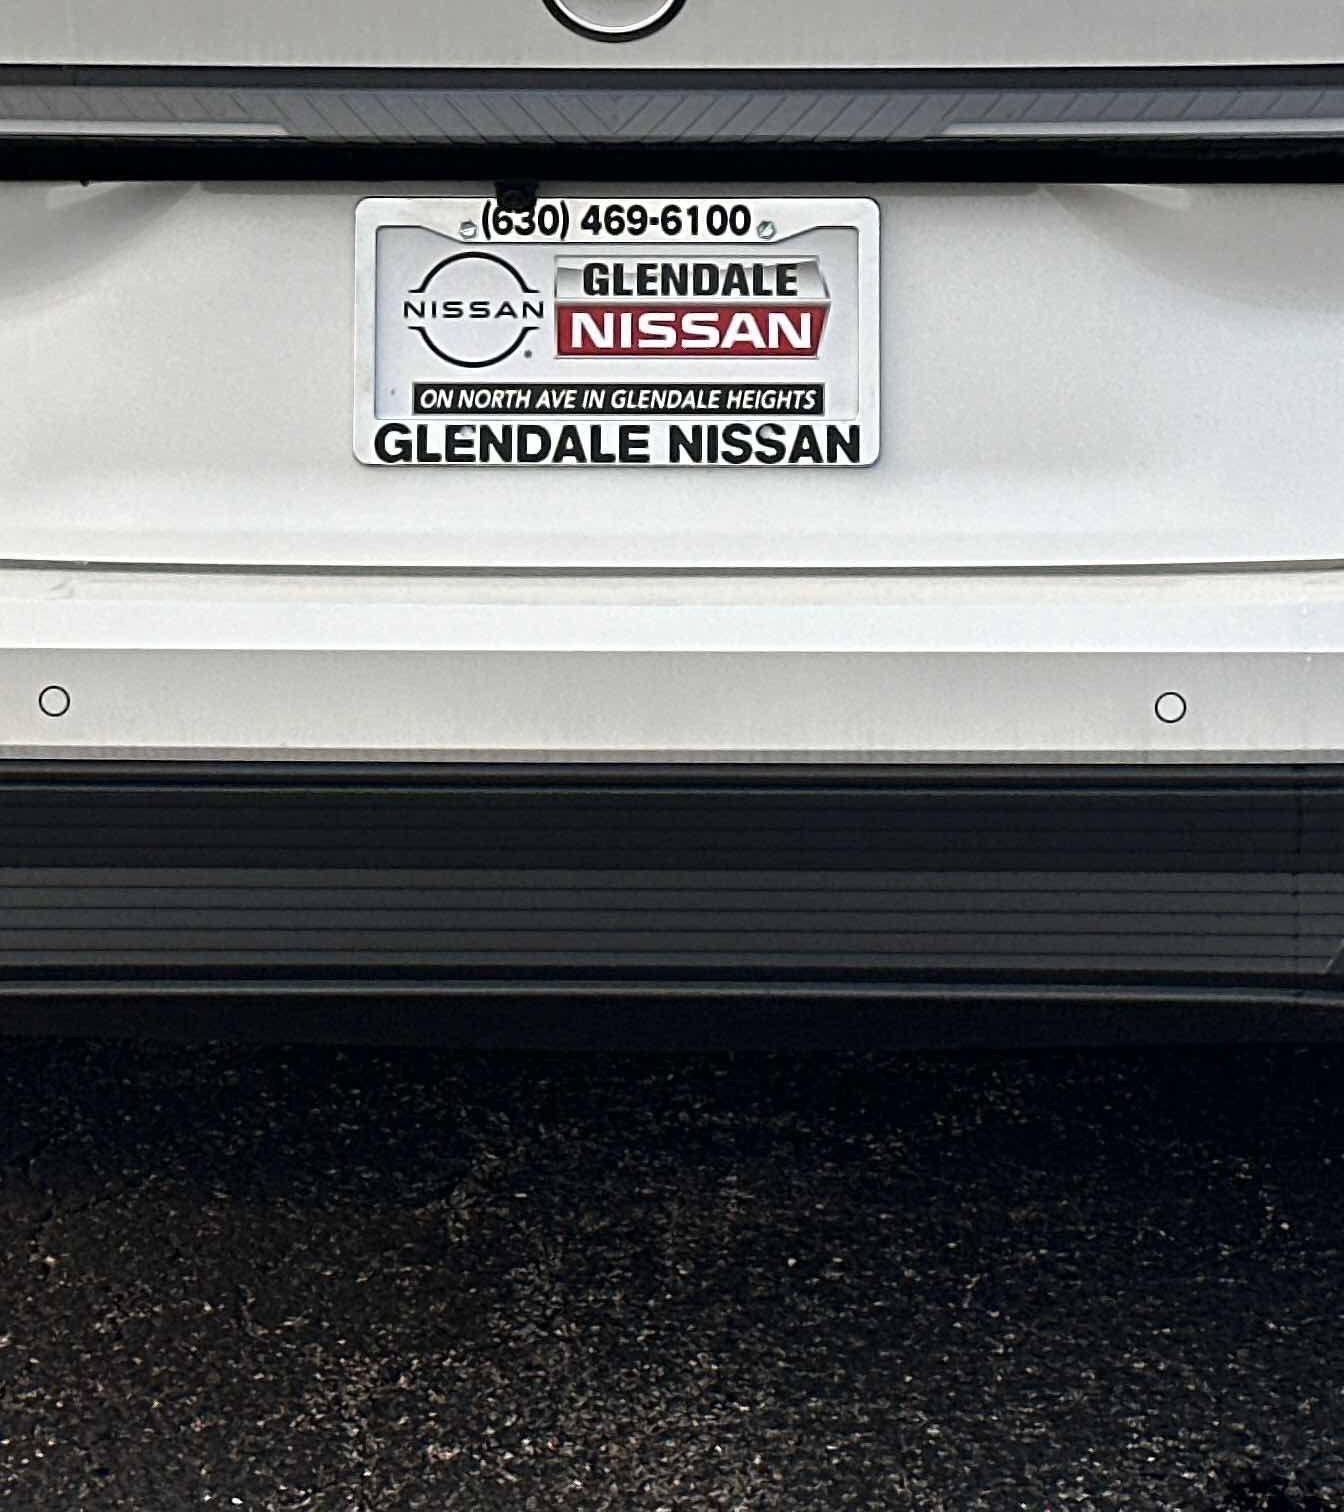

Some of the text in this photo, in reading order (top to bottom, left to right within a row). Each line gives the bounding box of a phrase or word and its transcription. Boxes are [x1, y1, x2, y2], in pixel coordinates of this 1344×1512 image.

[482, 200, 751, 240] (630) 469-6100
[583, 262, 798, 297] GLENDALE
[403, 300, 544, 320] NISSAN
[571, 312, 811, 349] NISSAN
[420, 389, 817, 410] ON NORTH AVE IN GLENDALE HEIGHTS
[373, 423, 860, 464] GLENDALE NISSAN
